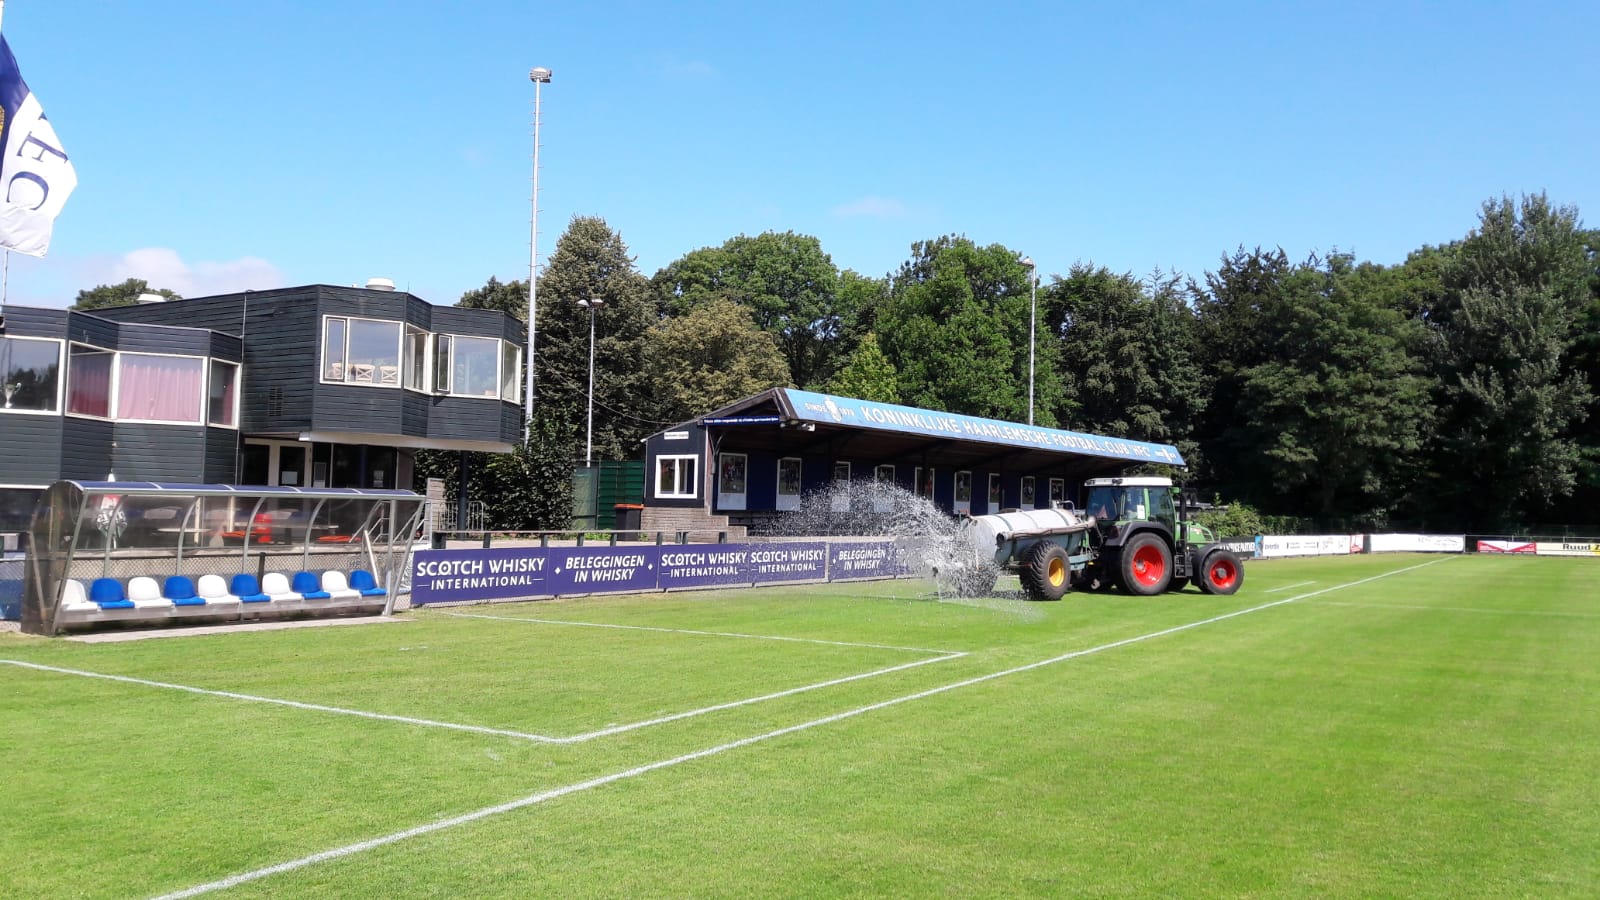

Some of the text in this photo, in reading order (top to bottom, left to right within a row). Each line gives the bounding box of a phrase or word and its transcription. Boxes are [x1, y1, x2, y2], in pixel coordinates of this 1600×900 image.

[862, 407, 961, 432] KONINKLIJKE
[963, 421, 1050, 444] HAARLEMSCHE
[1053, 434, 1105, 451] FOOTBALL
[1105, 441, 1129, 454] CLUB
[565, 554, 645, 570] BELEGGINGEN
[661, 551, 748, 566] SCOTCH WHISKY
[750, 549, 825, 563] SCOTCH WHISKY
[838, 548, 886, 561] BELEGGINGEN
[416, 557, 546, 577] SCOTCH WHISKY
[670, 566, 739, 578] INTERNATIONAL
[758, 563, 817, 574] INTERNATIONAL
[844, 559, 881, 571] IN WHISKY
[430, 575, 533, 590] INTERNATIONAL
[574, 568, 636, 583] IN WHISKY
